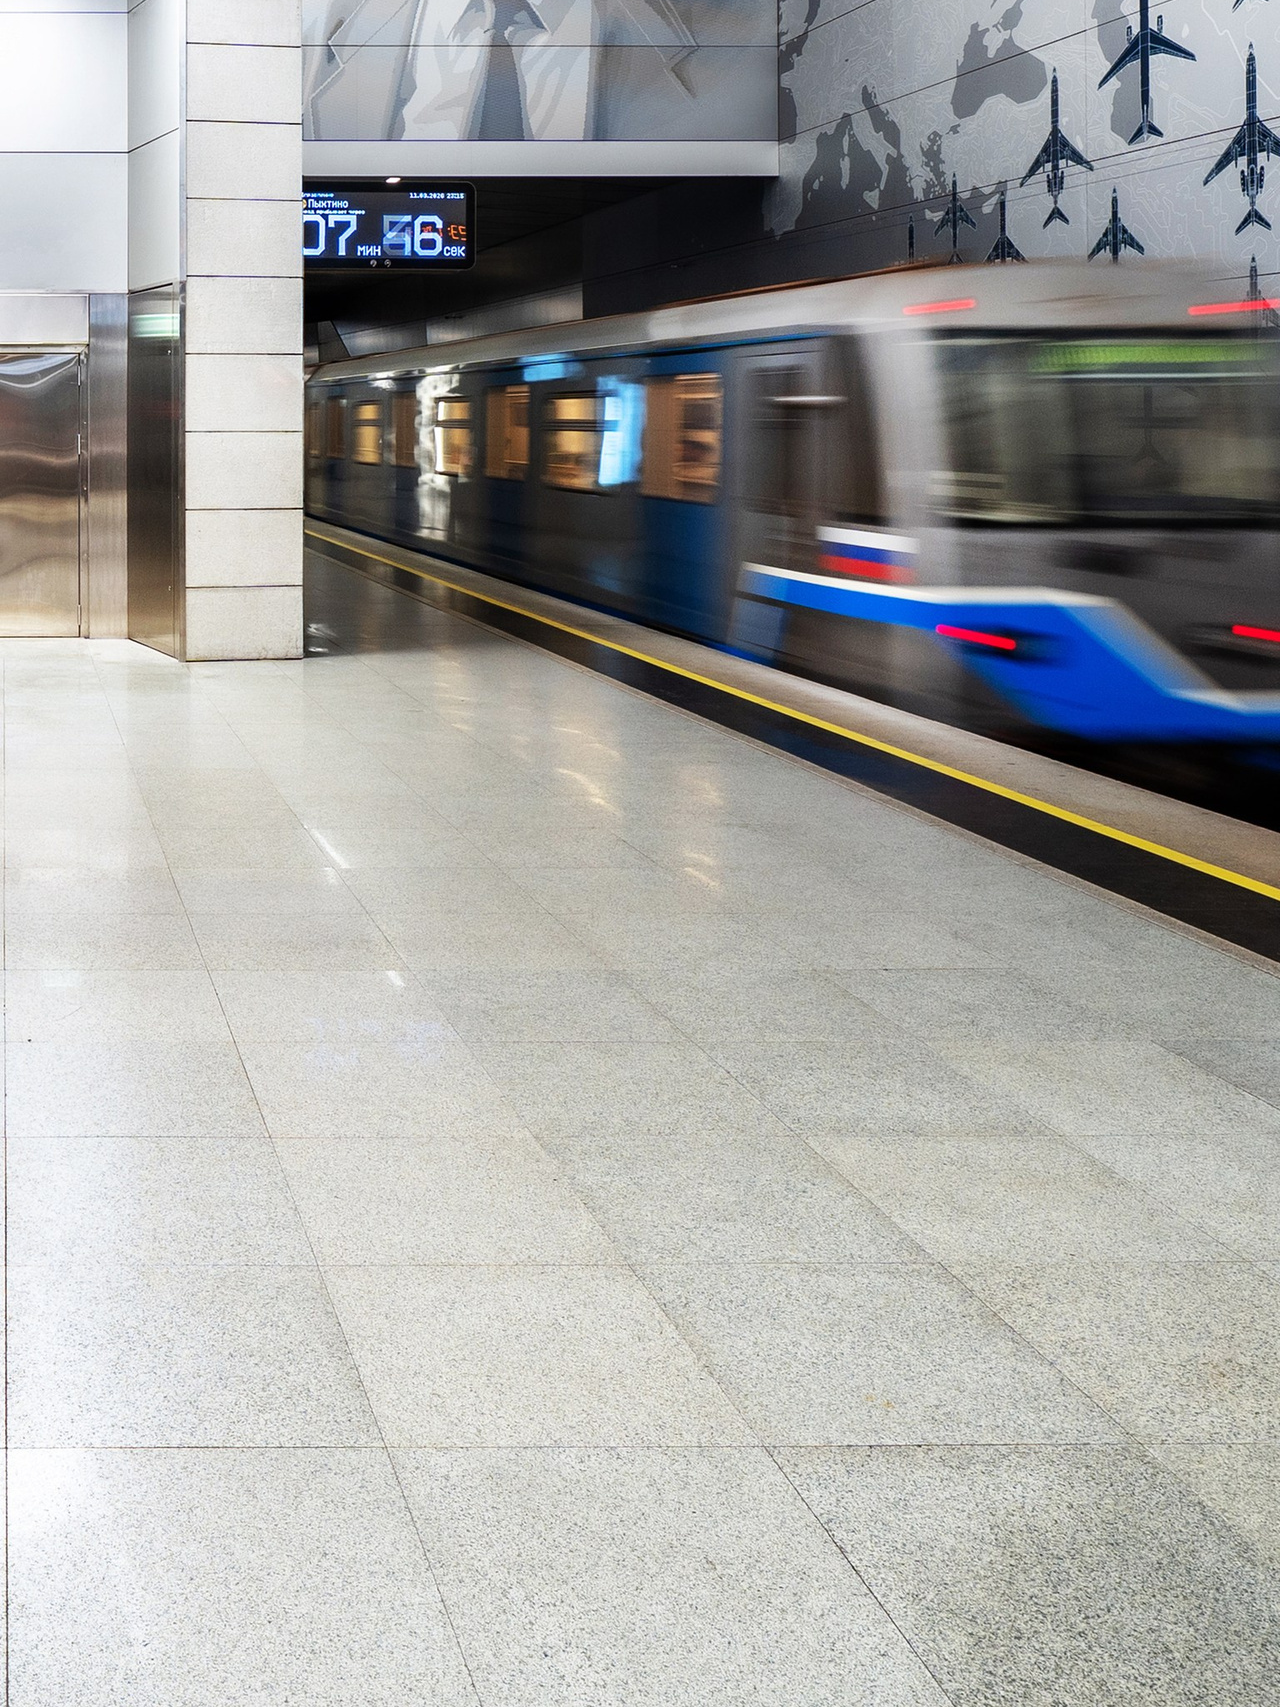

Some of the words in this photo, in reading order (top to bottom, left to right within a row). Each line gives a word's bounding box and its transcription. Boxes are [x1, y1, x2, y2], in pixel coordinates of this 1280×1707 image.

[307, 198, 349, 209] Пыхтино
[303, 214, 358, 256] 07
[357, 245, 382, 256] мин
[443, 245, 466, 257] сек
